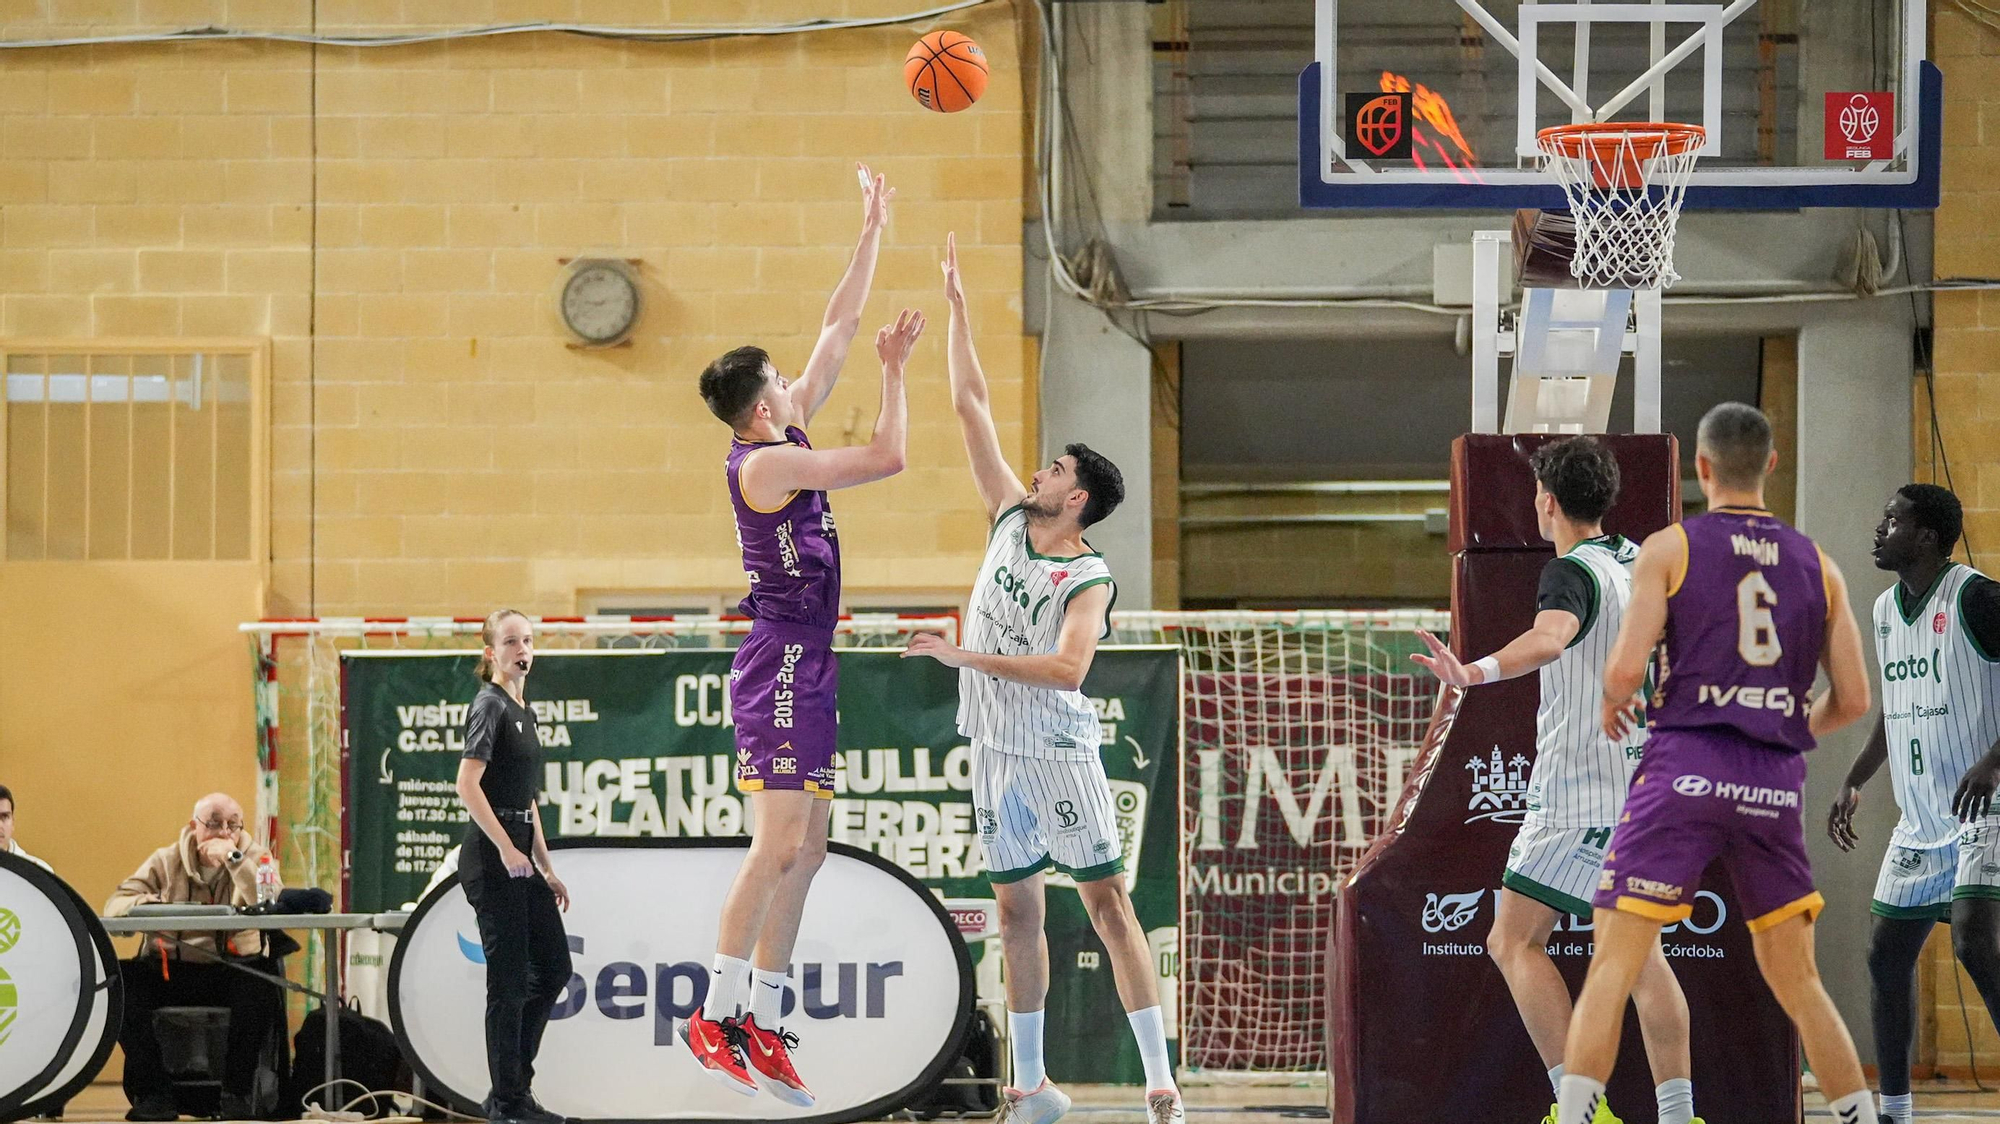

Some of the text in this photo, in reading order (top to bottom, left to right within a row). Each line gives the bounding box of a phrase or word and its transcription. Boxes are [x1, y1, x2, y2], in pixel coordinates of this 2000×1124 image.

[1383, 98, 1398, 106] FEB
[1846, 150, 1872, 159] FEB
[994, 566, 1030, 609] coto
[1737, 571, 1782, 666] 6
[1884, 654, 1929, 682] coto
[773, 643, 803, 729] 2015-2025
[1698, 684, 1796, 717] IVECO
[772, 757, 797, 770] CBC
[1911, 738, 1924, 775] 8
[397, 778, 456, 792] miércole
[536, 757, 652, 805] UCE
[1715, 780, 1799, 808] HYUNDAI
[396, 808, 413, 821] de
[395, 844, 413, 858] de
[950, 912, 986, 924] DECO
[1422, 942, 1483, 956] Instituto
[1564, 942, 1583, 956] de
[1661, 943, 1725, 958] Córdoba
